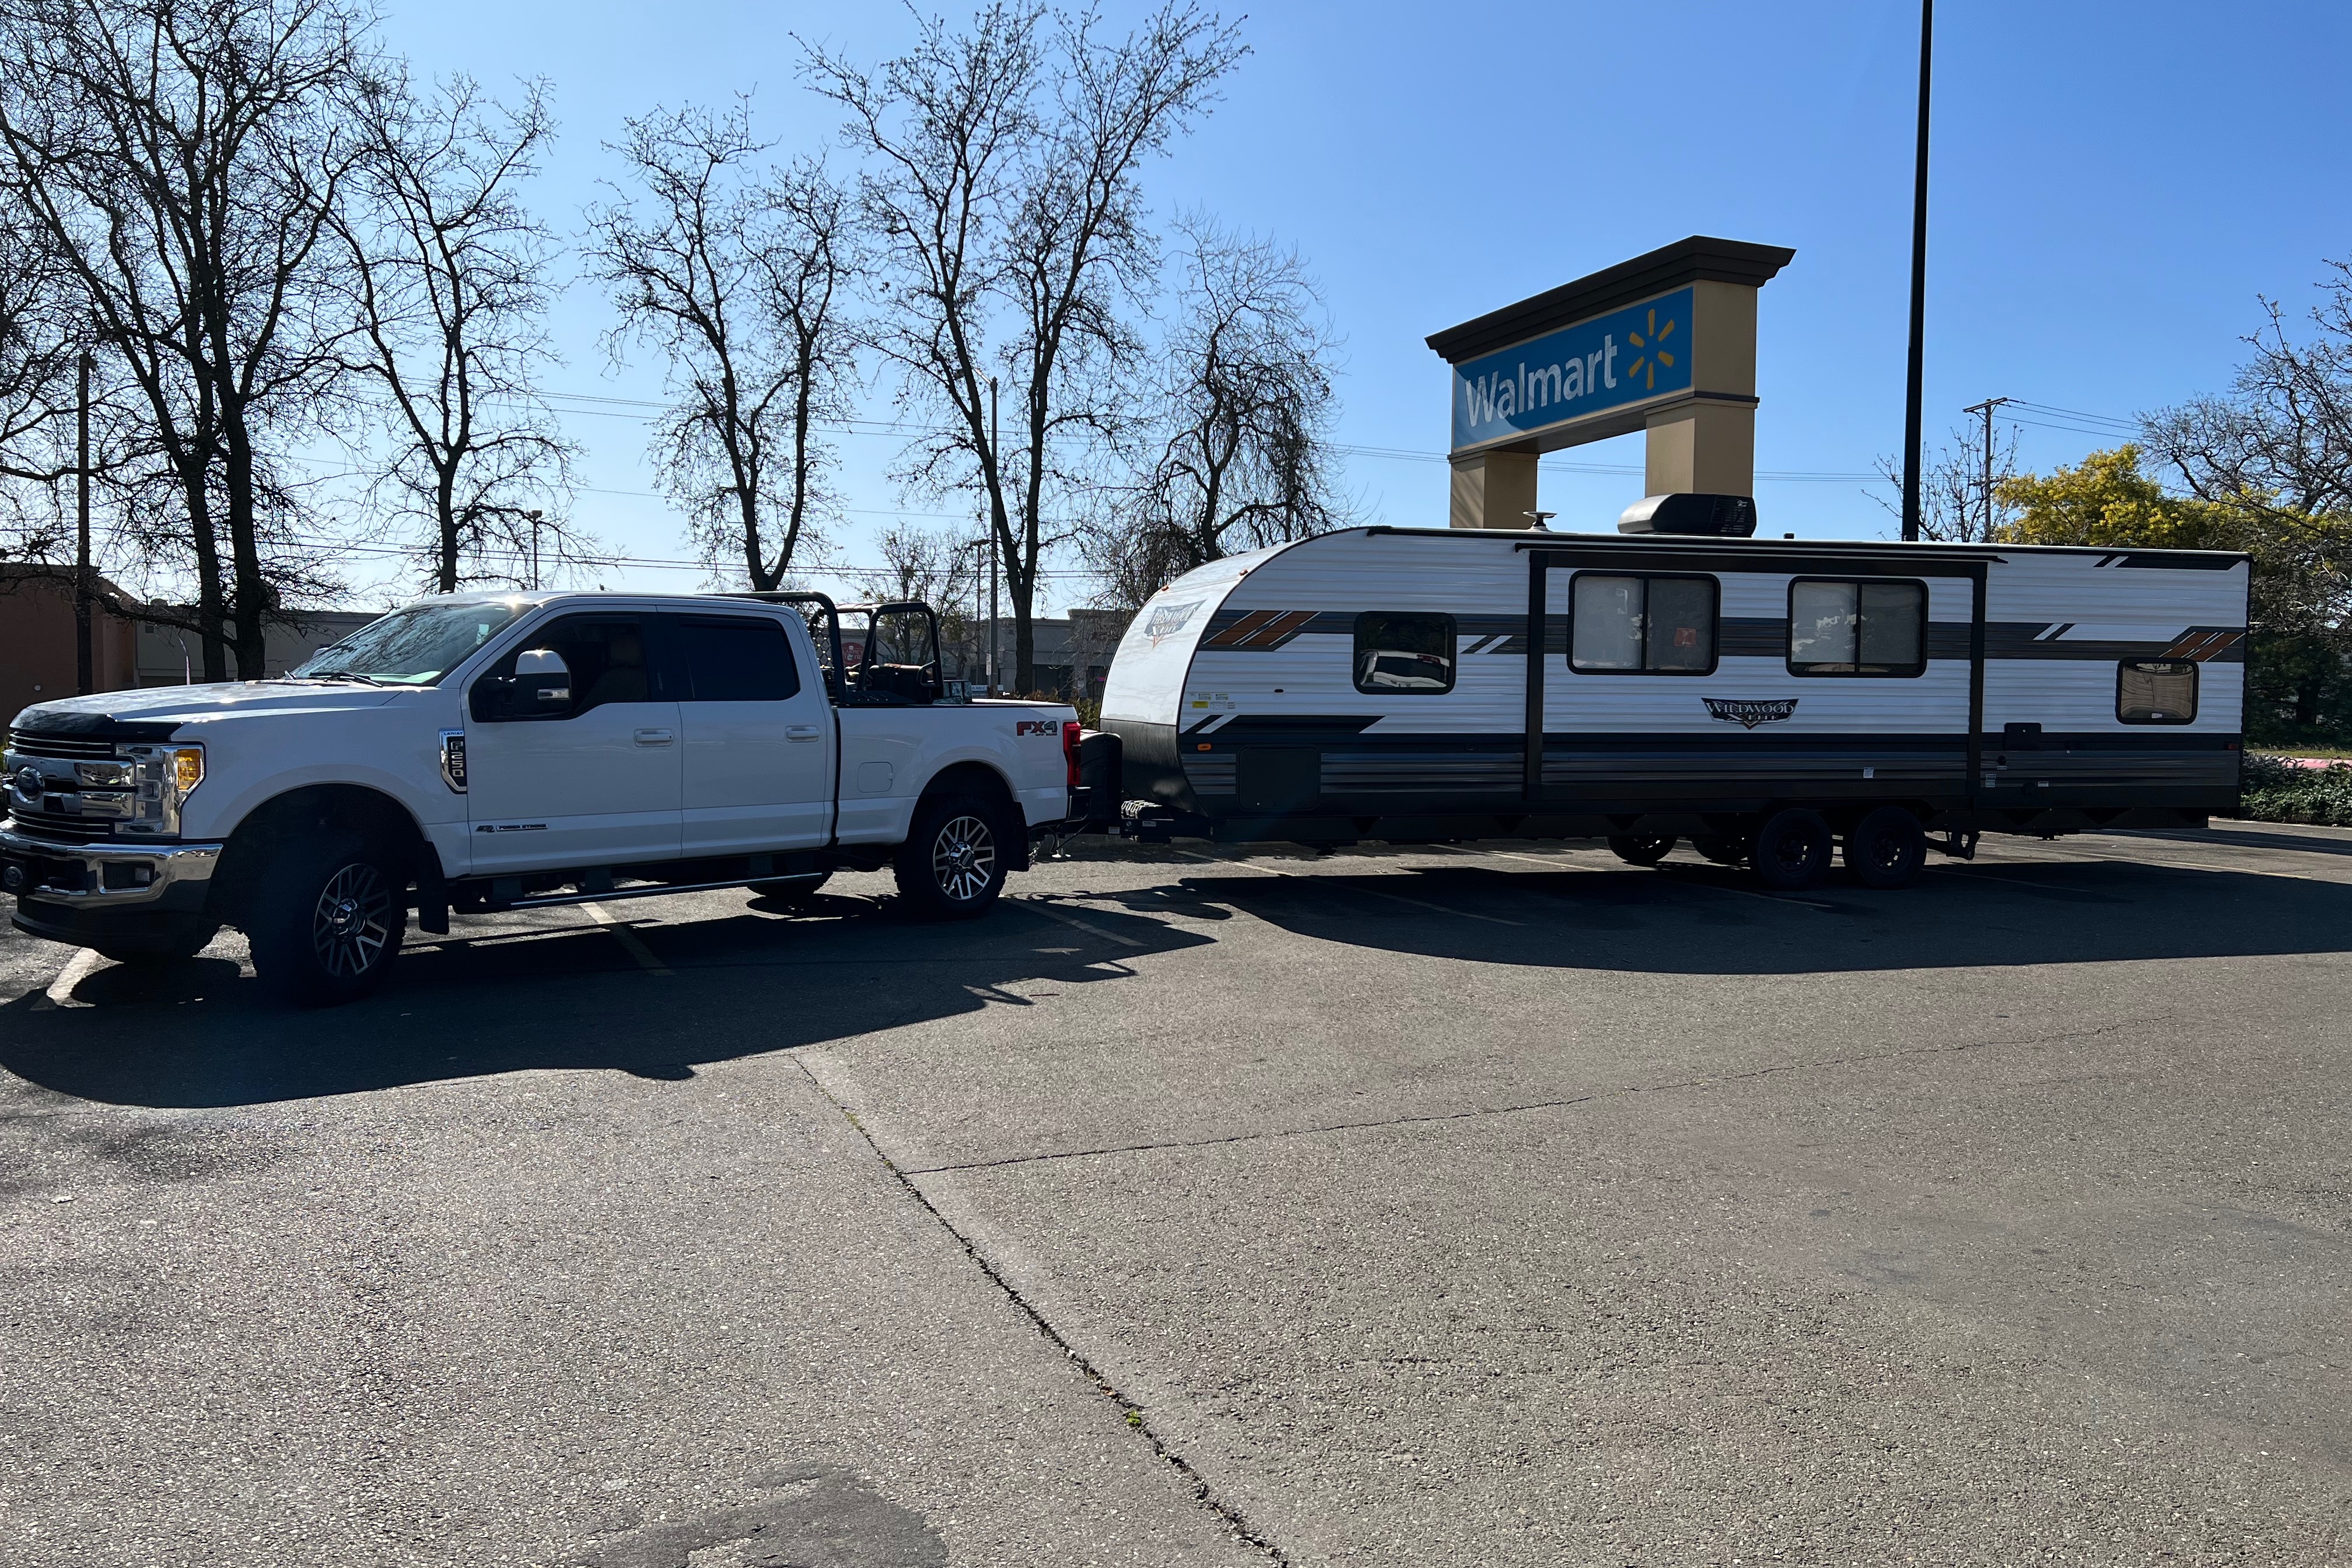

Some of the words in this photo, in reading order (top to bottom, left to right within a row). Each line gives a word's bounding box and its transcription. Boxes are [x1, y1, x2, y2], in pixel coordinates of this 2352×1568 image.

[1465, 334, 1618, 428] Walmart
[1706, 702, 1794, 713] WILDWOOD
[1016, 720, 1058, 736] FX4
[450, 741, 464, 777] F250
